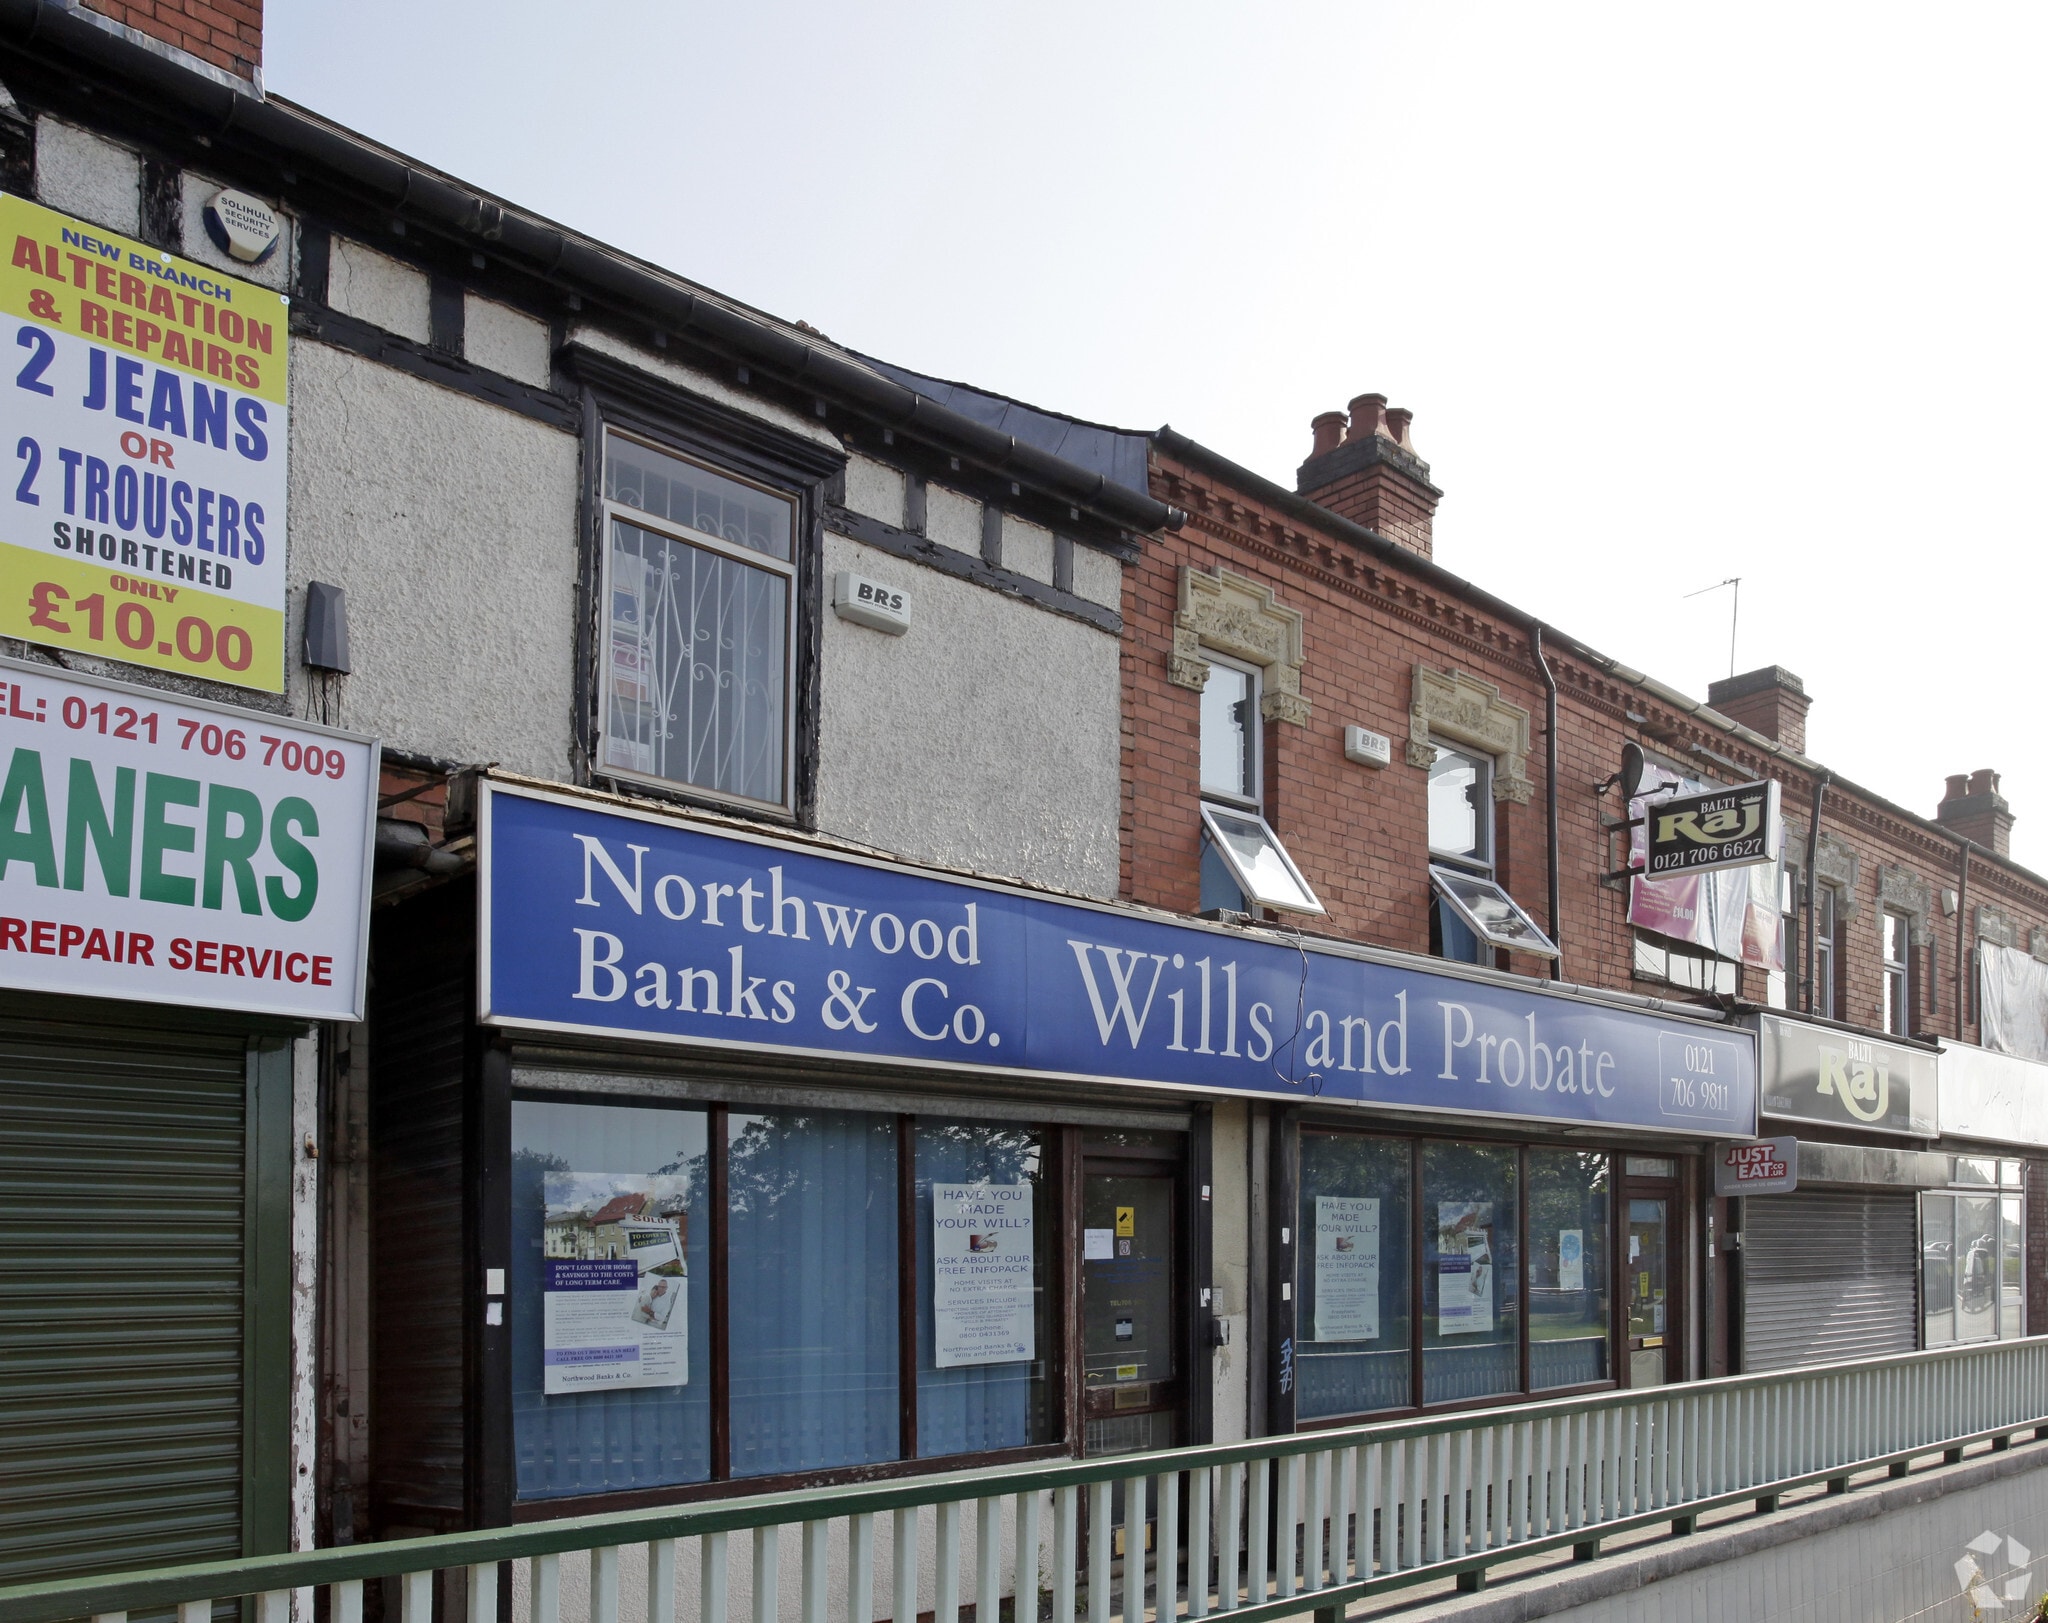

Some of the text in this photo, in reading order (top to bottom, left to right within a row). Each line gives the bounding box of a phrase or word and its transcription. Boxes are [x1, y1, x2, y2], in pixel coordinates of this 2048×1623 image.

[221, 197, 274, 224] SOLIHULL
[225, 208, 270, 230] SECURITY
[225, 217, 270, 239] SERVICES
[61, 228, 231, 302] NEW BRANCH
[11, 235, 272, 355] ALTERATION
[28, 289, 260, 388] & REPAIRS
[16, 325, 268, 461] 2 JEANS
[120, 431, 175, 469] OR
[16, 436, 265, 566] 2 TROUSERS
[54, 521, 231, 590] SHORTENED
[110, 575, 179, 603] ONLY
[858, 583, 902, 609] BRS
[28, 581, 252, 671] £10.00
[0, 681, 345, 780] L: 0121 706 7009
[1362, 734, 1386, 751] BRS
[1700, 797, 1737, 814] BALTI
[0, 747, 320, 922] ANERS
[1654, 838, 1762, 869] 0121 706 6627
[573, 833, 981, 966] Northwood
[0, 917, 333, 986] REPAIR SERVICE
[572, 927, 1000, 1048] Banks & Co.
[1067, 939, 1616, 1098] Wills and Probate
[1685, 1044, 1715, 1075] 0121
[1848, 1041, 1872, 1063] BALTI
[1671, 1077, 1729, 1111] 706 9811
[1728, 1146, 1773, 1164] JUST
[1738, 1162, 1773, 1179] EAT
[944, 1190, 1022, 1200] HAVE YOU
[1322, 1202, 1346, 1210] HAVE
[936, 1218, 1030, 1228] YOUR WILL?
[962, 1256, 1001, 1264] ABOUT
[971, 1265, 1028, 1273] INFOPACK
[943, 1345, 982, 1353] Northwood
